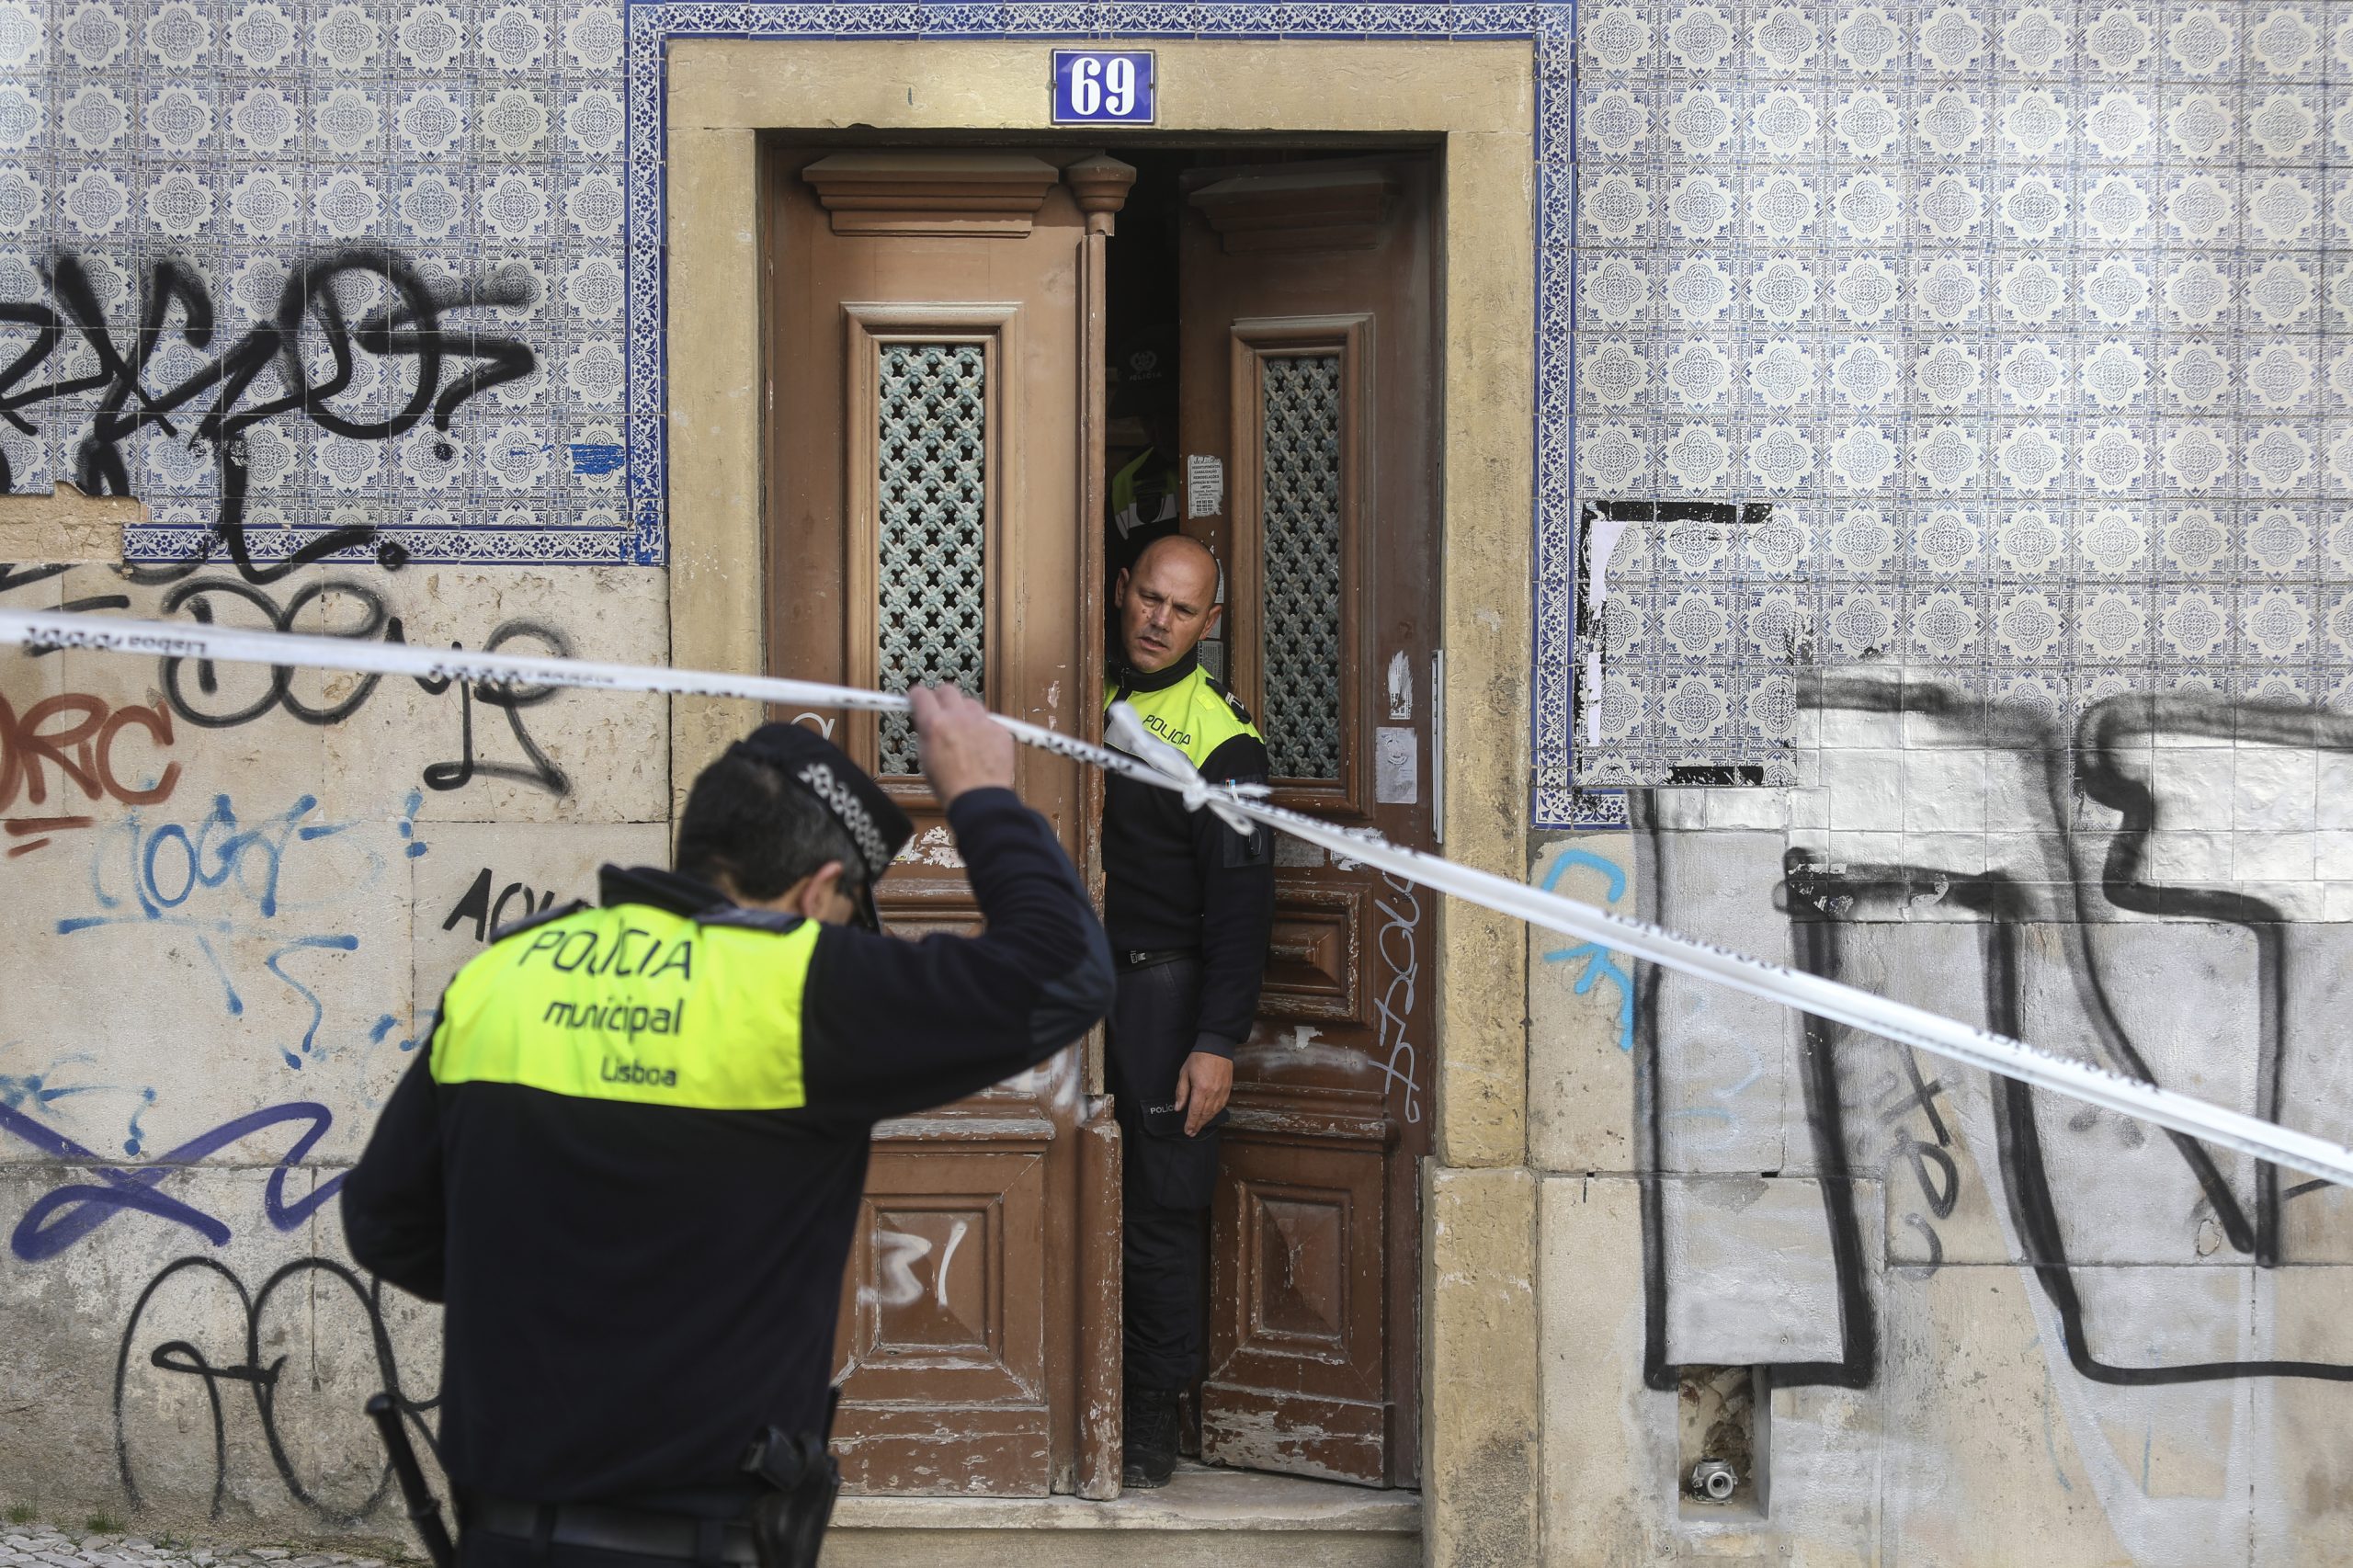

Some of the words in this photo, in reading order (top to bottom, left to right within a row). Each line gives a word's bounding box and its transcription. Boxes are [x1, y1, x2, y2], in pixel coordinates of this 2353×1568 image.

[1071, 57, 1135, 116] 69
[543, 995, 685, 1044] municipal
[601, 1055, 677, 1087] Lisboa
